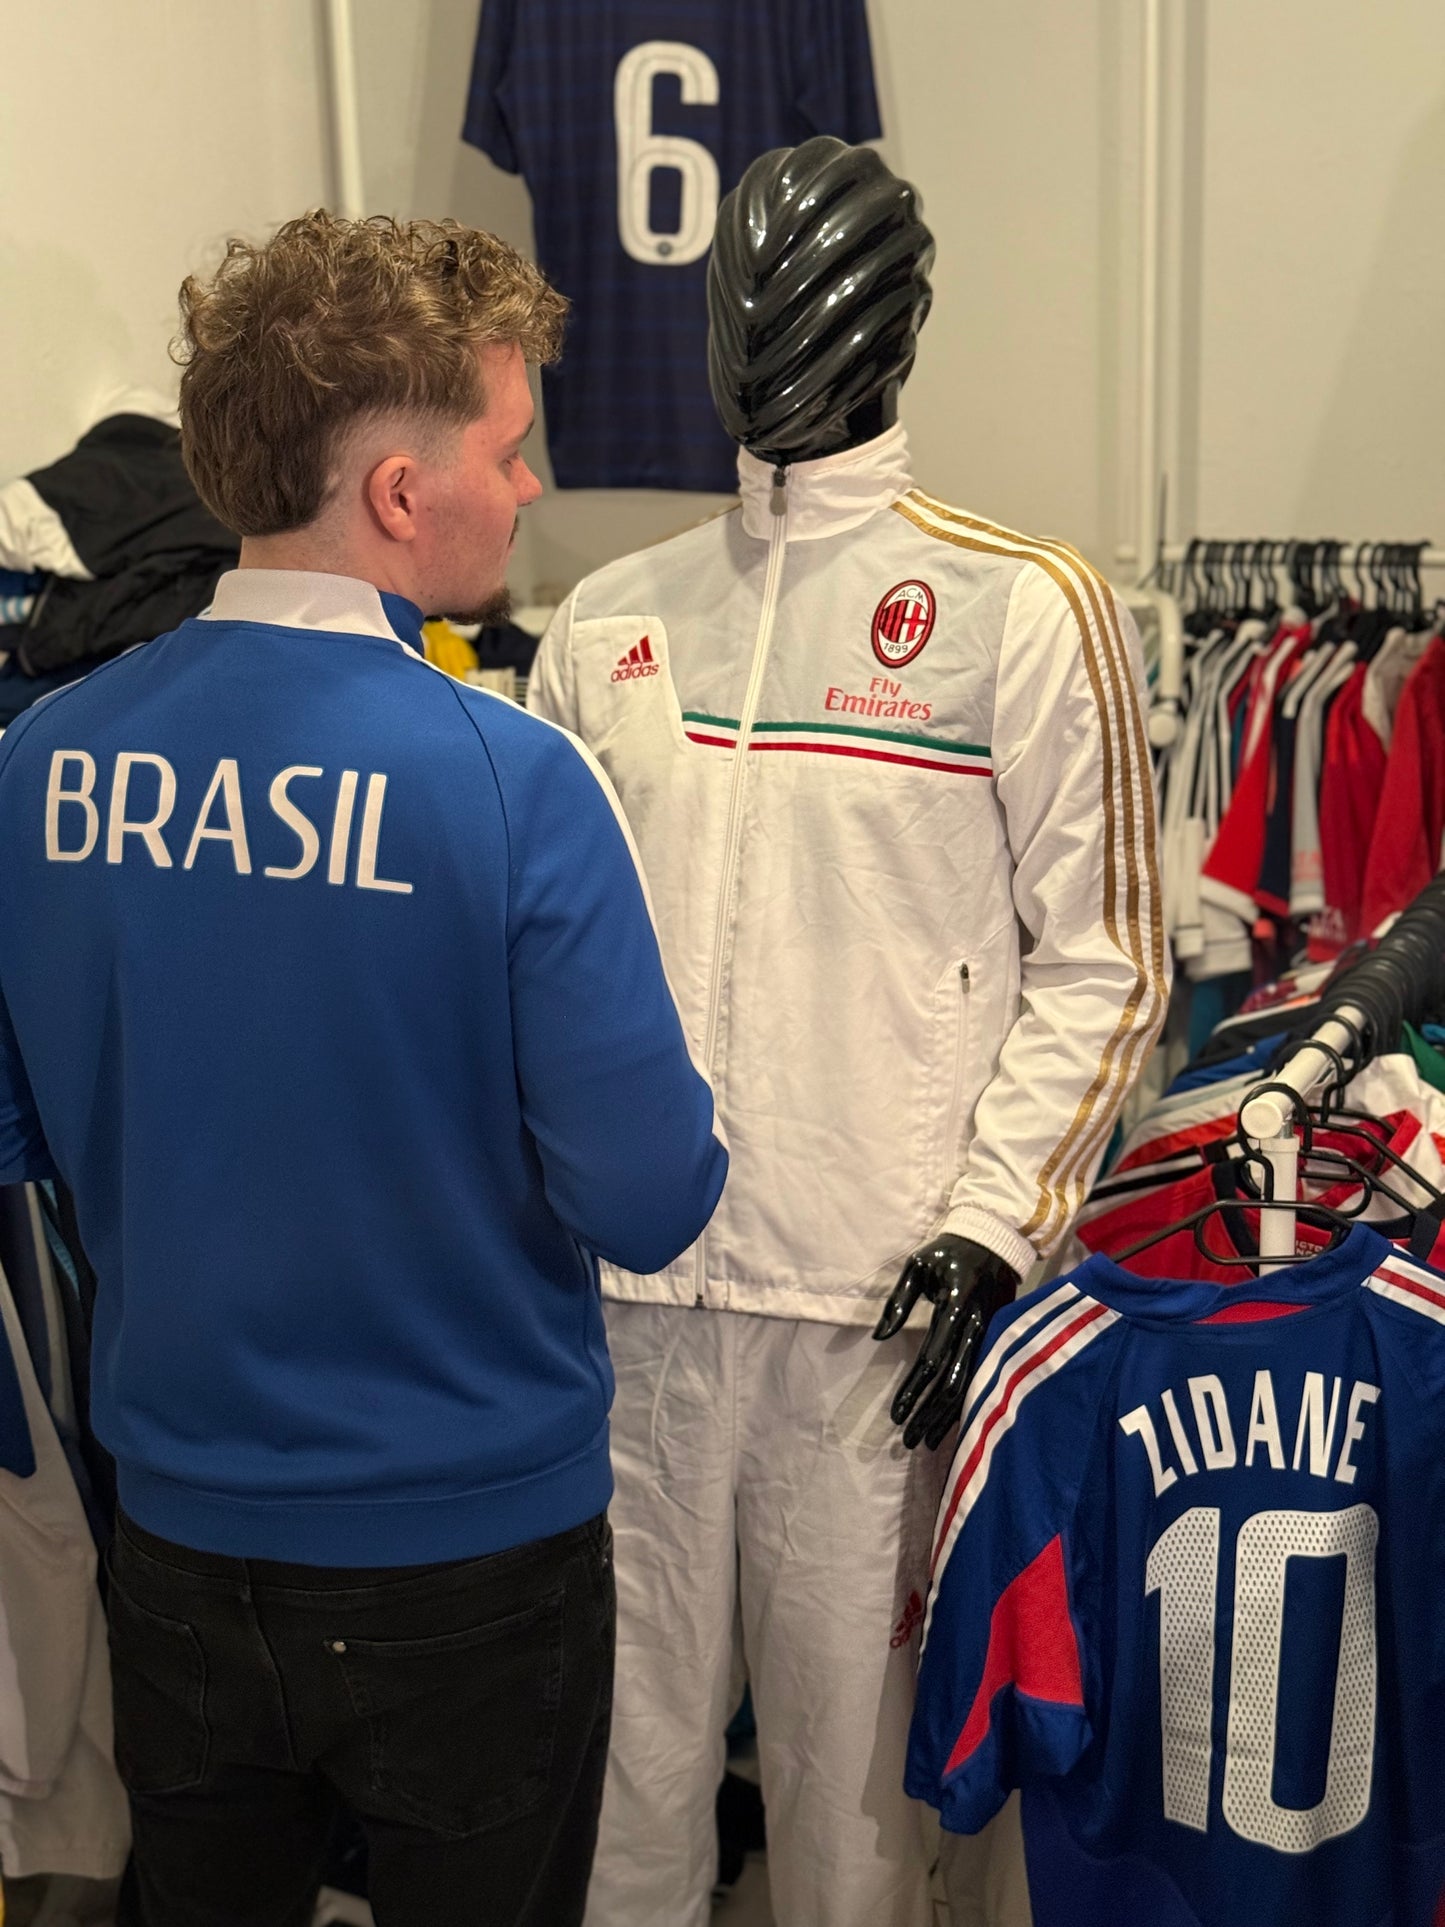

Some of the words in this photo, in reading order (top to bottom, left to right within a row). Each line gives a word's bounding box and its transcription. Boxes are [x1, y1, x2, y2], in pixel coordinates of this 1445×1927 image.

[614, 40, 720, 266] 6
[895, 587, 924, 603] ACM
[884, 642, 908, 653] 1899
[611, 663, 660, 683] adidas
[869, 677, 902, 698] Fly
[825, 687, 933, 721] Emirates
[45, 750, 414, 894] BRASIL
[1118, 1369, 1382, 1499] ZIDANE
[1145, 1503, 1380, 1854] 10
